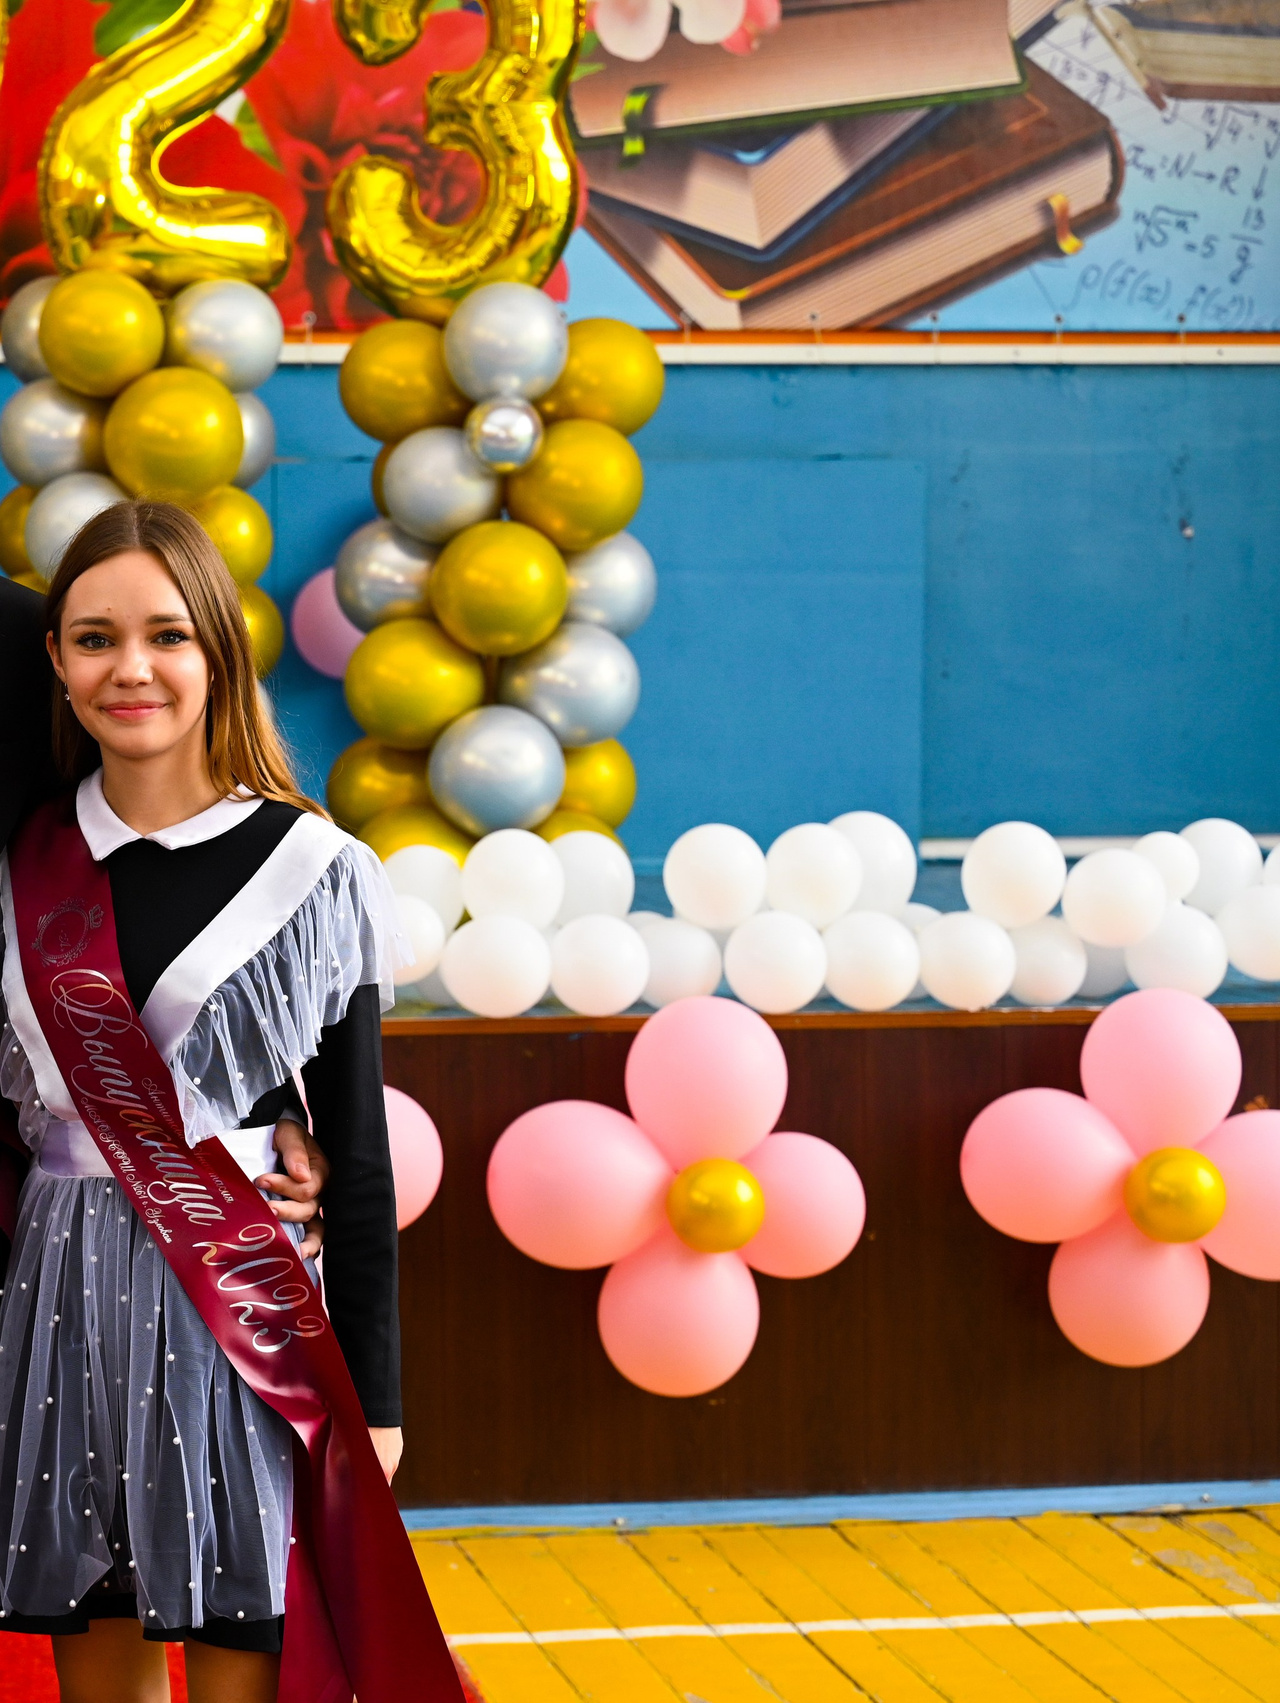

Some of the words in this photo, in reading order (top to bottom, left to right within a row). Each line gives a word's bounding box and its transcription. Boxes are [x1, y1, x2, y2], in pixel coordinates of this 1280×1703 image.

[50, 968, 226, 1227] Выпускница
[192, 1223, 325, 1354] 2023
[144, 1207, 173, 1244] Узловая
